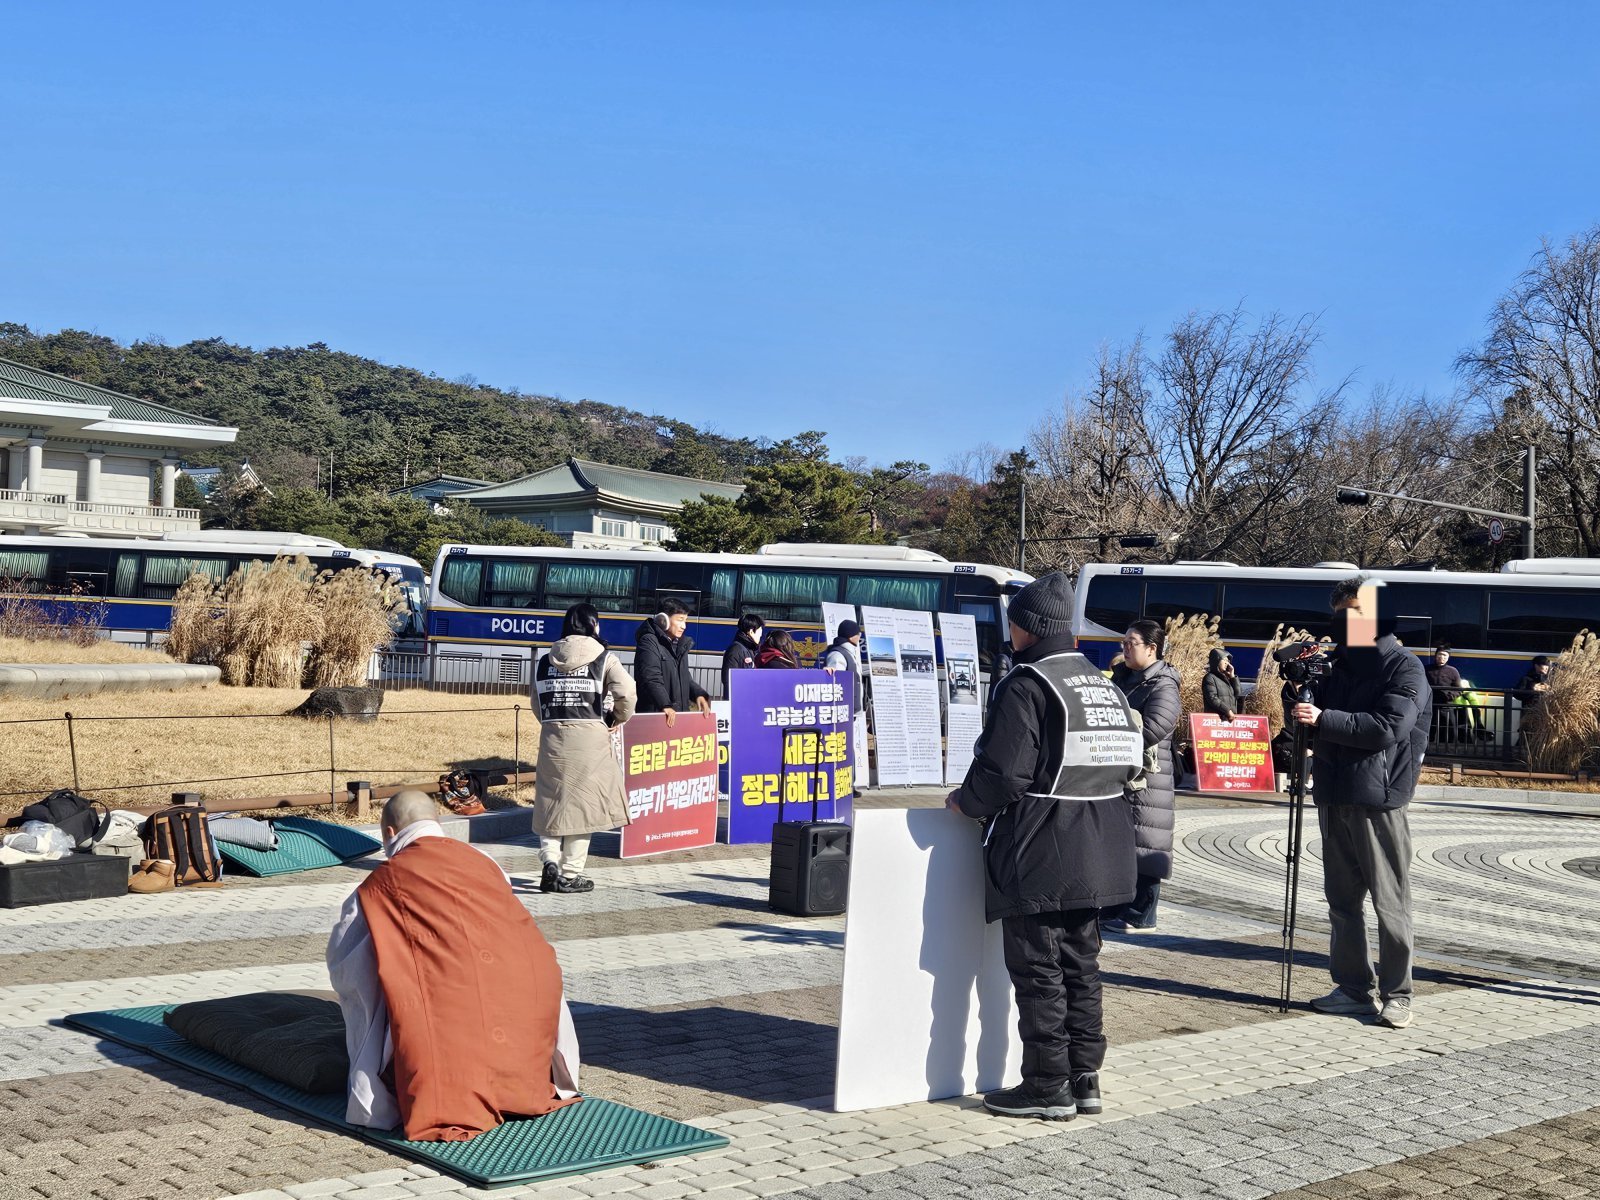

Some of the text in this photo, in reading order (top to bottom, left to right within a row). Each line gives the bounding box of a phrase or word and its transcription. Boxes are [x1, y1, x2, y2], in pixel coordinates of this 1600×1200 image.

[1491, 525, 1501, 536] 40
[491, 617, 544, 635] POLICE
[1074, 686, 1121, 706] 강제단속
[763, 706, 816, 726] 고공농성
[1084, 707, 1128, 727] 중단하라
[1080, 735, 1093, 743] Stop
[1094, 734, 1111, 742] Forced
[630, 741, 668, 775] 옵티칼
[668, 733, 715, 767] 고용승계
[1091, 755, 1112, 764] Migrant
[1231, 753, 1265, 766] 탁상행정
[1216, 766, 1256, 778] 규탄한다!!
[629, 774, 716, 819] 정부가 책임져라!
[741, 772, 830, 806] 정리해고
